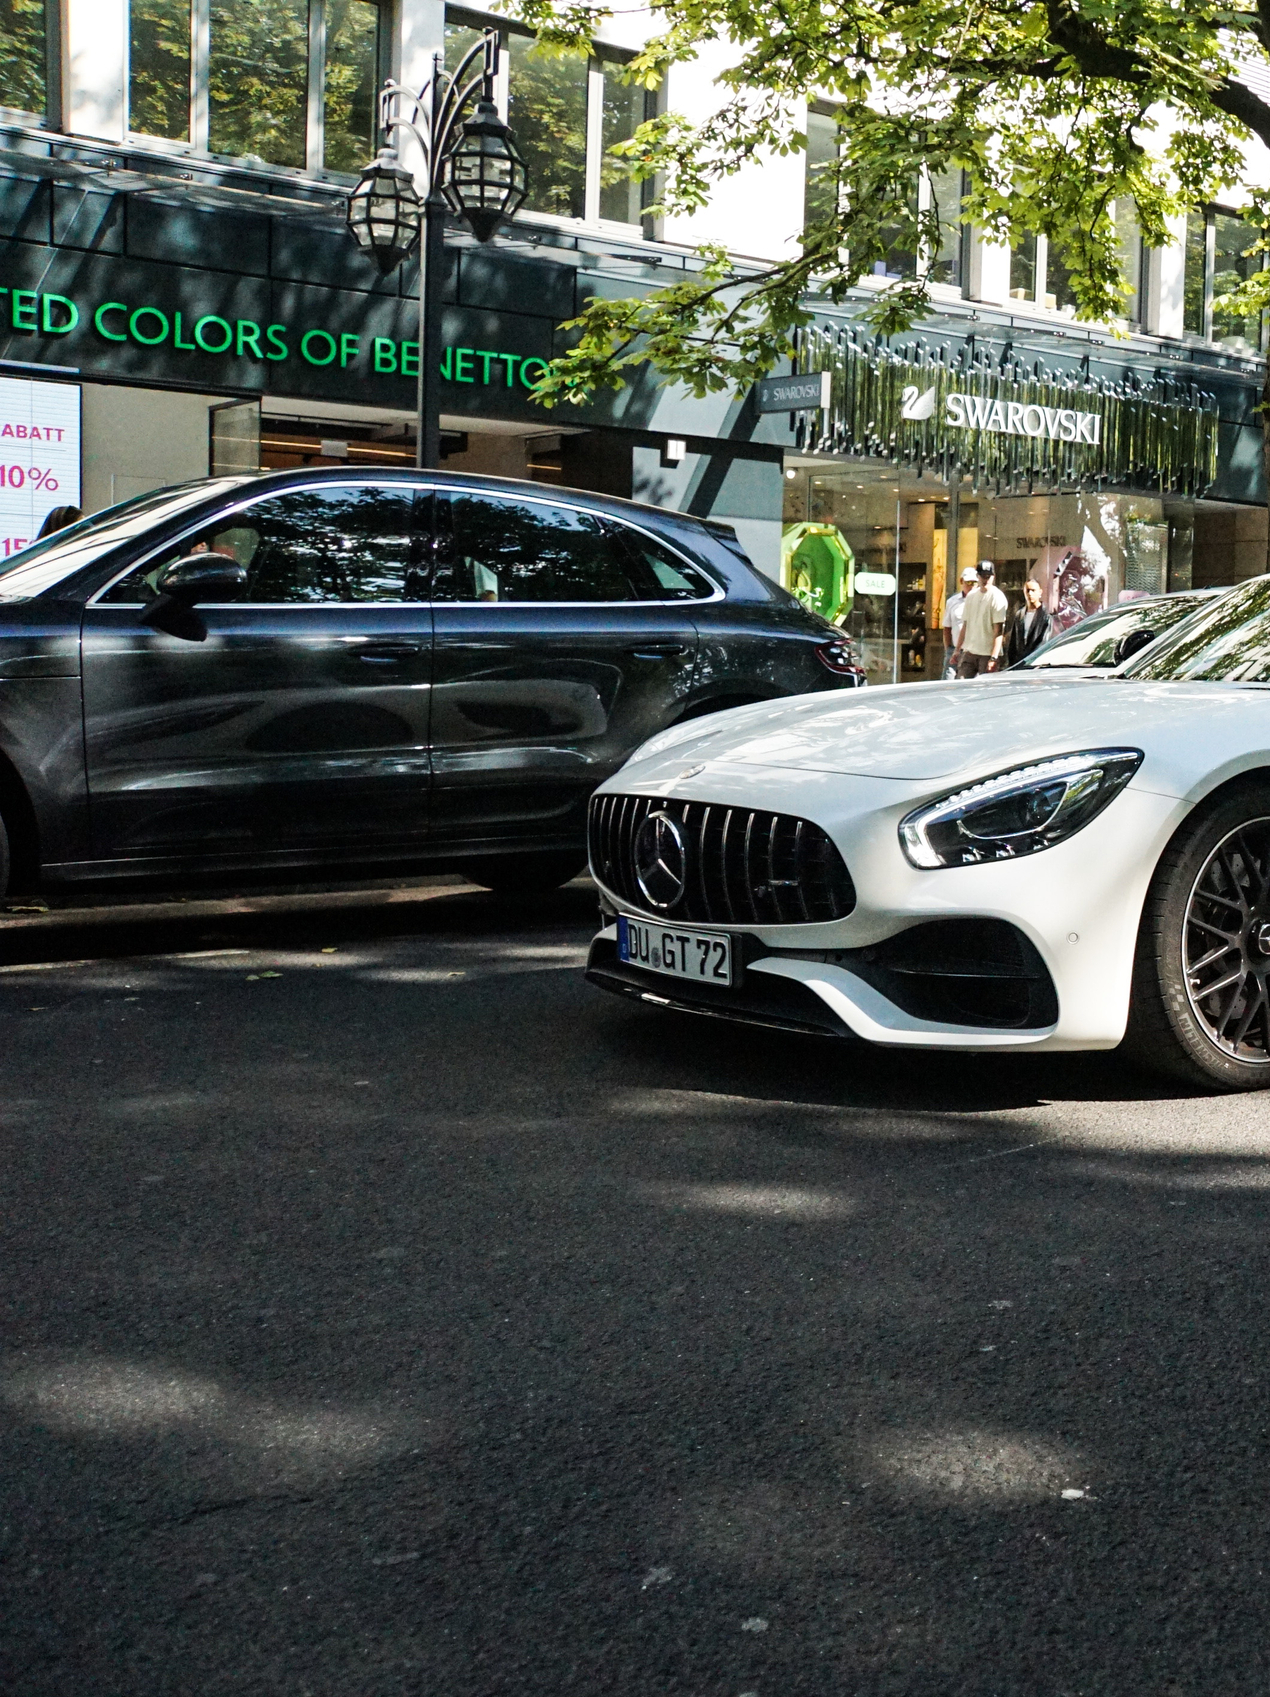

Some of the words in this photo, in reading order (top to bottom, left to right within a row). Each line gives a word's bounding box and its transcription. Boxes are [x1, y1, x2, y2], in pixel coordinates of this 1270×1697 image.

[0, 287, 79, 333] ED
[94, 302, 288, 361] COLORS
[301, 329, 360, 368] OF
[773, 384, 820, 401] SWAROVSKI
[945, 393, 1101, 445] SWAROVSKI
[865, 579, 885, 589] SALE
[628, 923, 649, 963] DU
[662, 932, 690, 972] GT
[696, 937, 728, 979] 72
